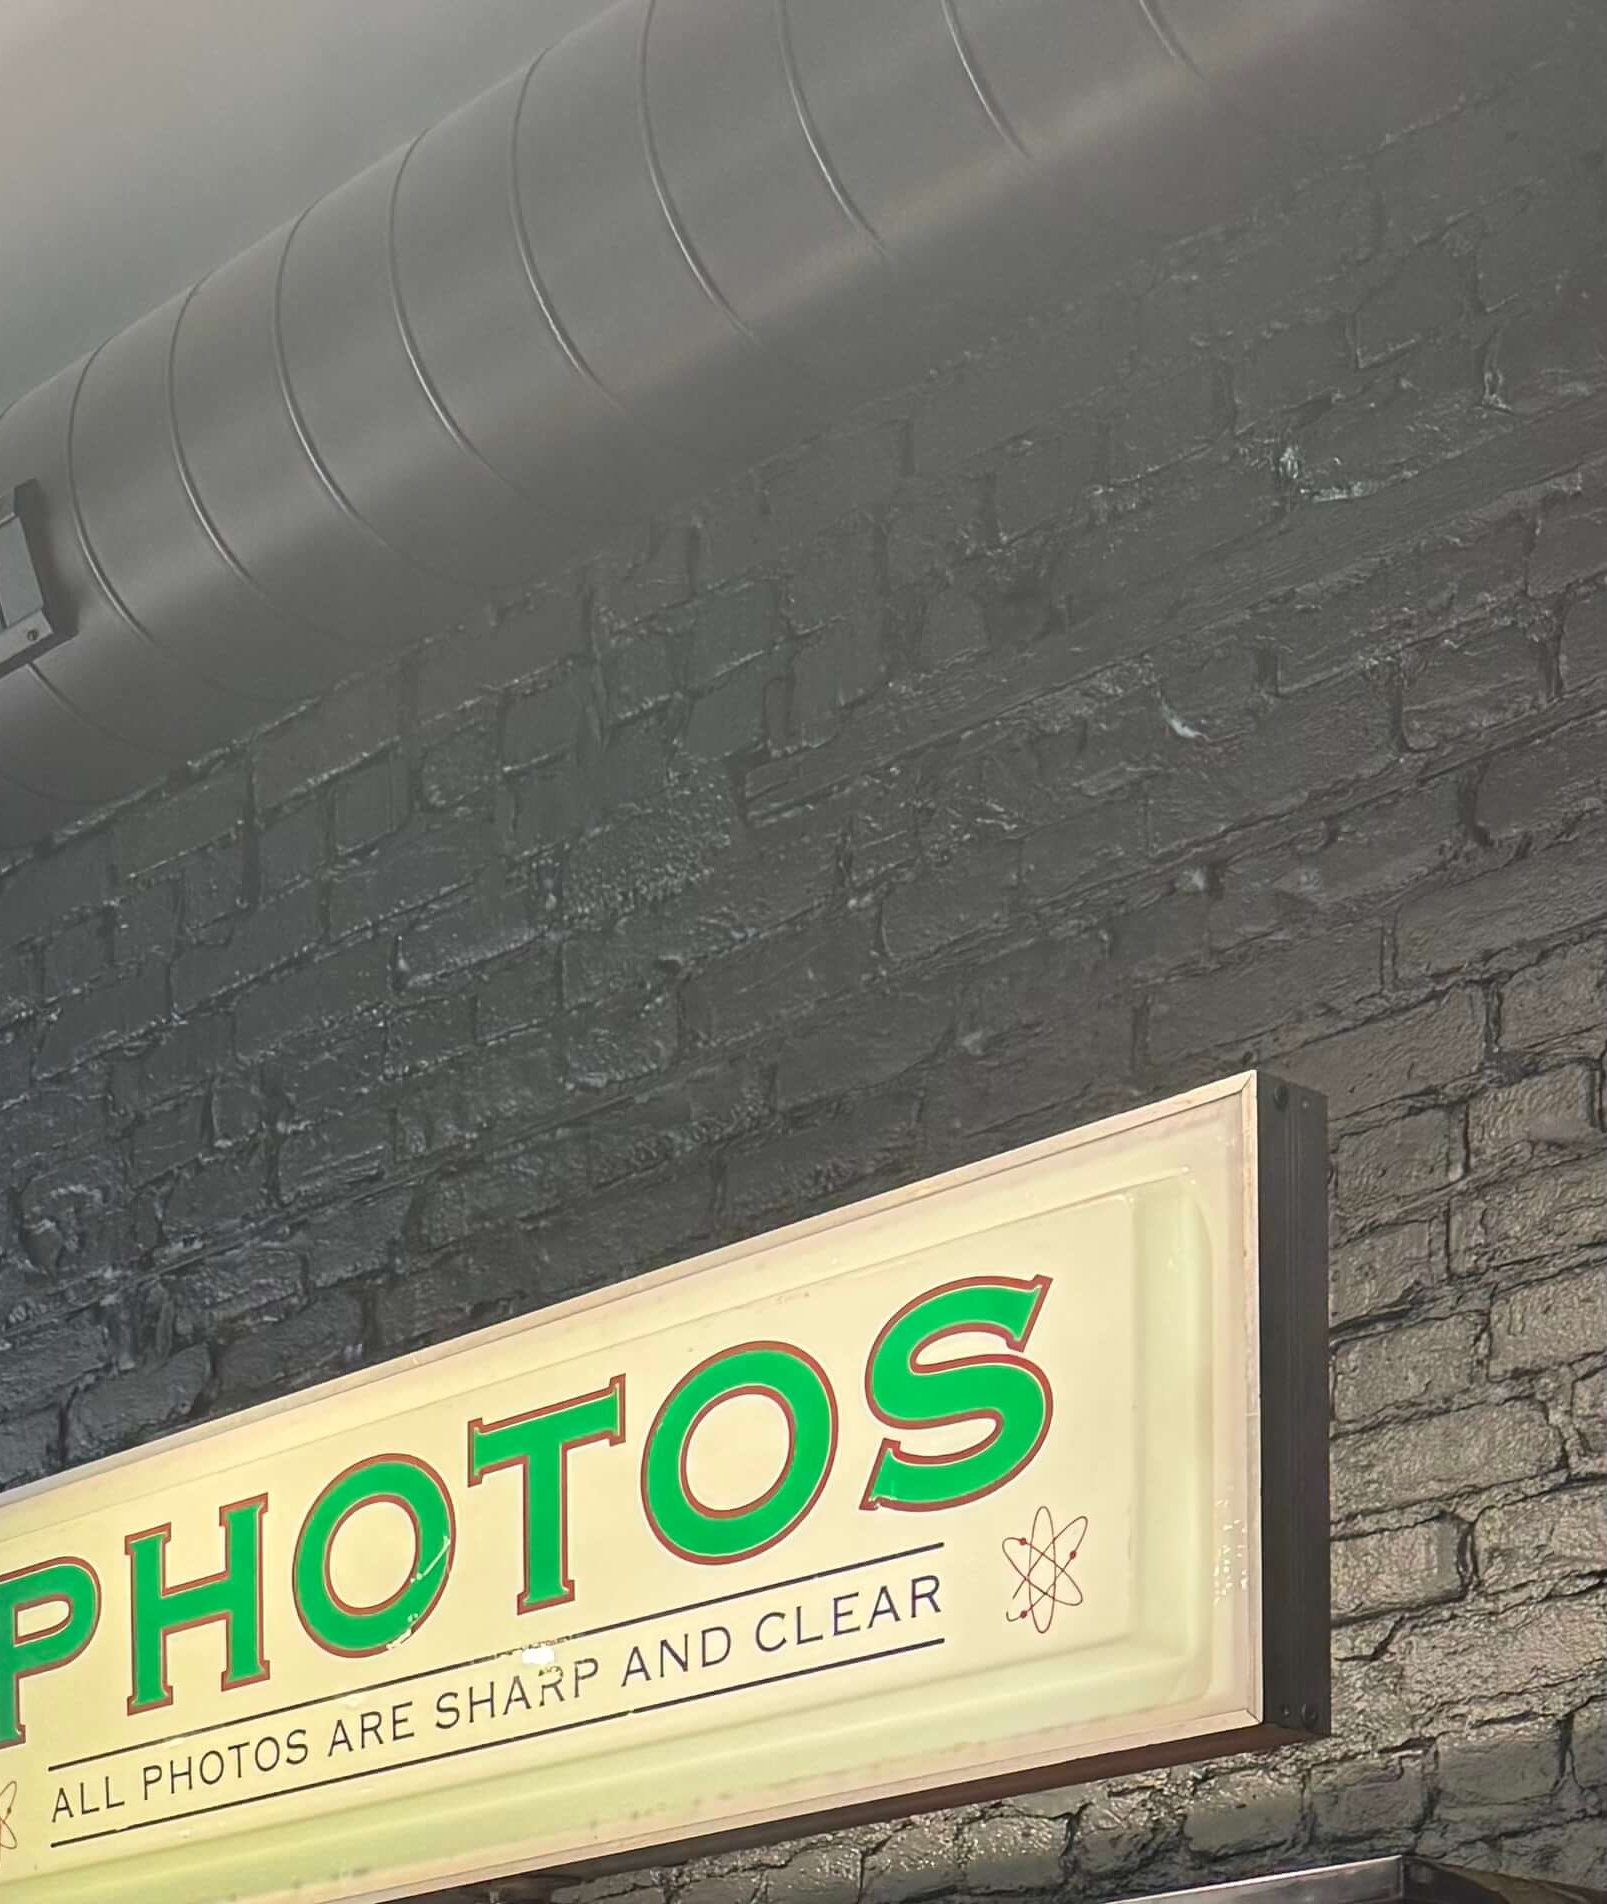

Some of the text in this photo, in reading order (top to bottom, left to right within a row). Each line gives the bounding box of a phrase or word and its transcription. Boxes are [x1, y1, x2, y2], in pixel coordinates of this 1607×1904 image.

[50, 1573, 943, 1823] ALL PHOTOS ARE SHARP AND CLEAR
